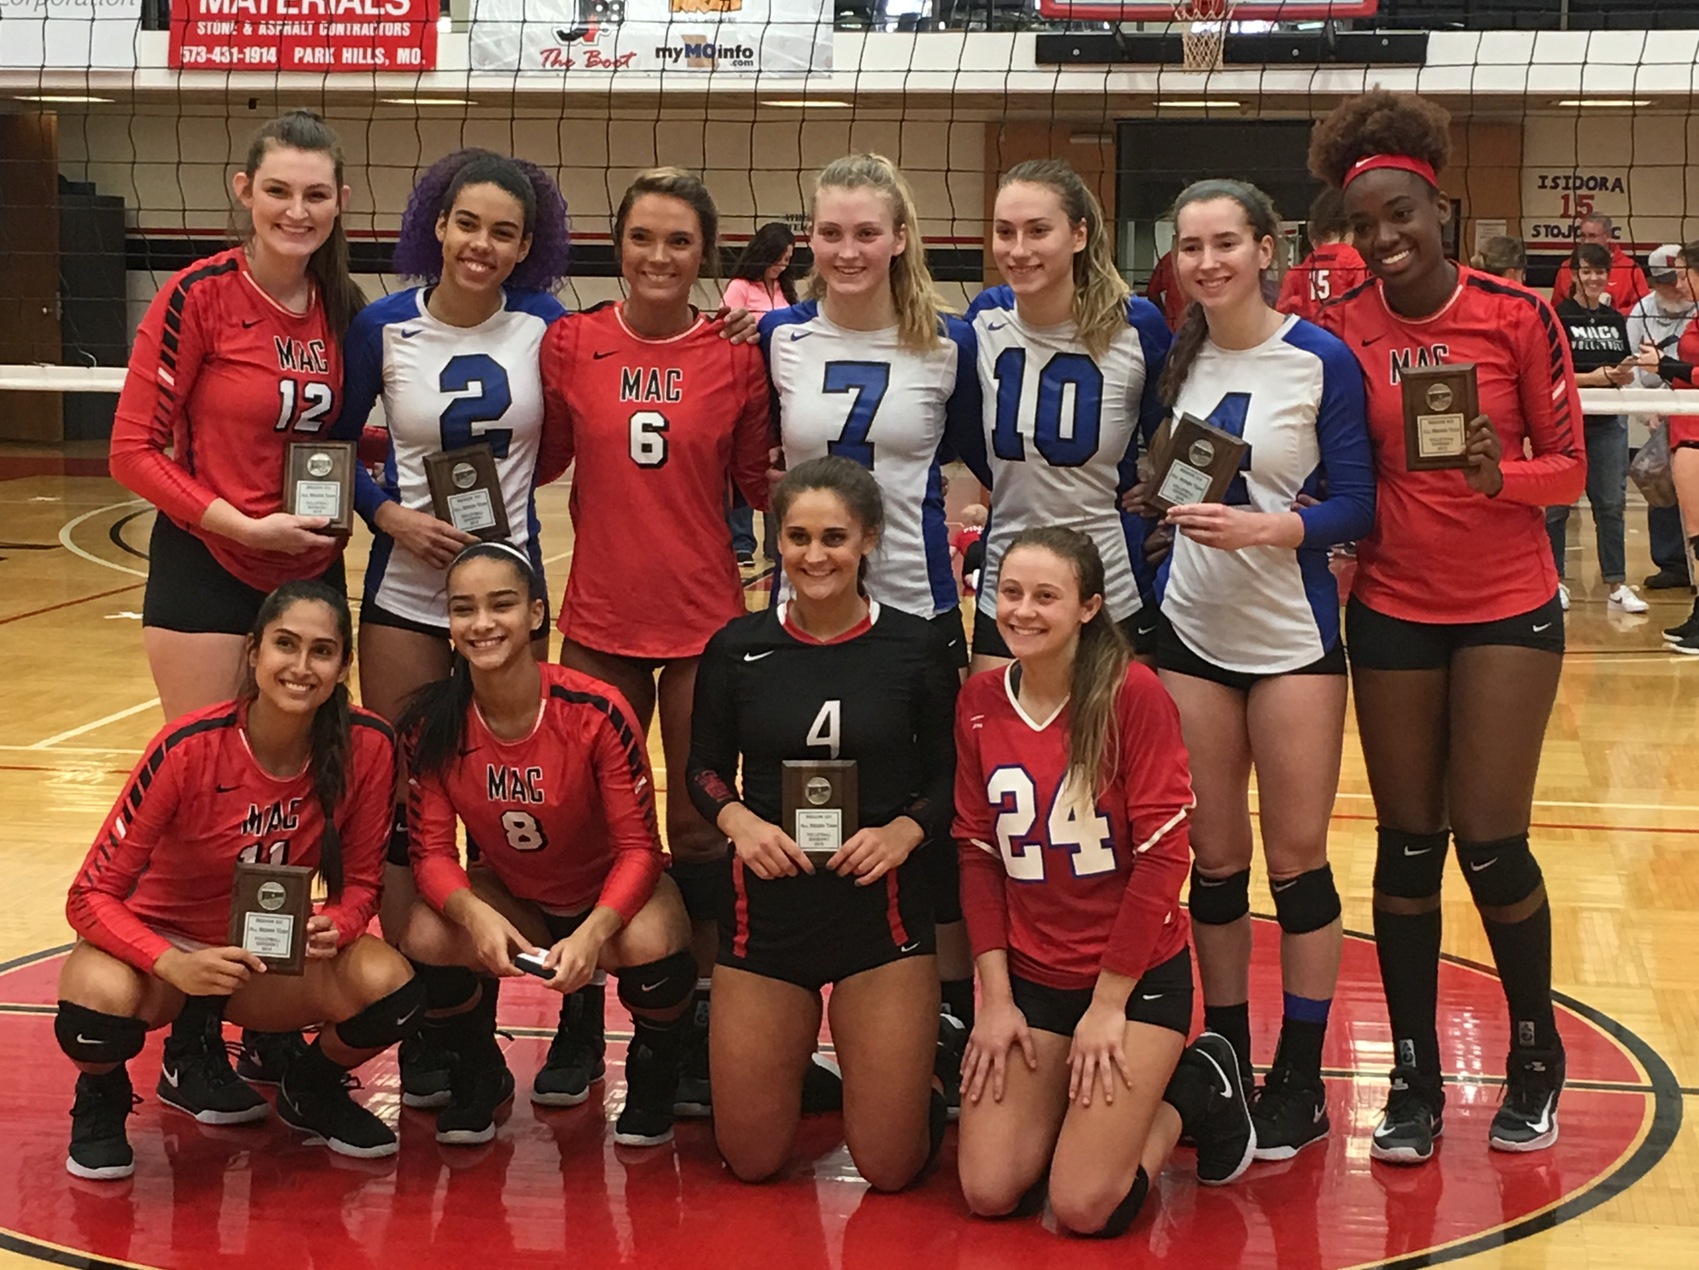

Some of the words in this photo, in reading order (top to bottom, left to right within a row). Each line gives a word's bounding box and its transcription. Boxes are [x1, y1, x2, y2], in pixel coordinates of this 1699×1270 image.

[0, 0, 135, 12] orporation
[197, 20, 237, 36] STONE
[243, 20, 253, 36] &
[258, 20, 315, 36] ASPHALT
[318, 20, 411, 37] CONTRACTORS
[181, 45, 278, 64] 573-431-1914
[294, 46, 336, 64] PARK
[342, 47, 389, 66] HILLS,
[540, 47, 576, 69] The
[583, 49, 637, 69] Boot
[655, 43, 754, 63] myMOinfo
[1537, 174, 1625, 194] ISIDORA
[1560, 193, 1596, 220] 15
[1308, 269, 1331, 301] 15
[273, 335, 329, 375] MAC
[274, 377, 334, 433] 12
[619, 366, 683, 404] MAC
[439, 353, 514, 459] 2
[822, 360, 892, 472] 7
[992, 346, 1105, 468] 10
[628, 410, 670, 469] 6
[806, 699, 841, 760] 4
[486, 763, 545, 805] MAC
[240, 797, 304, 837] MAC
[500, 809, 548, 853] 8
[984, 763, 1118, 884] 24
